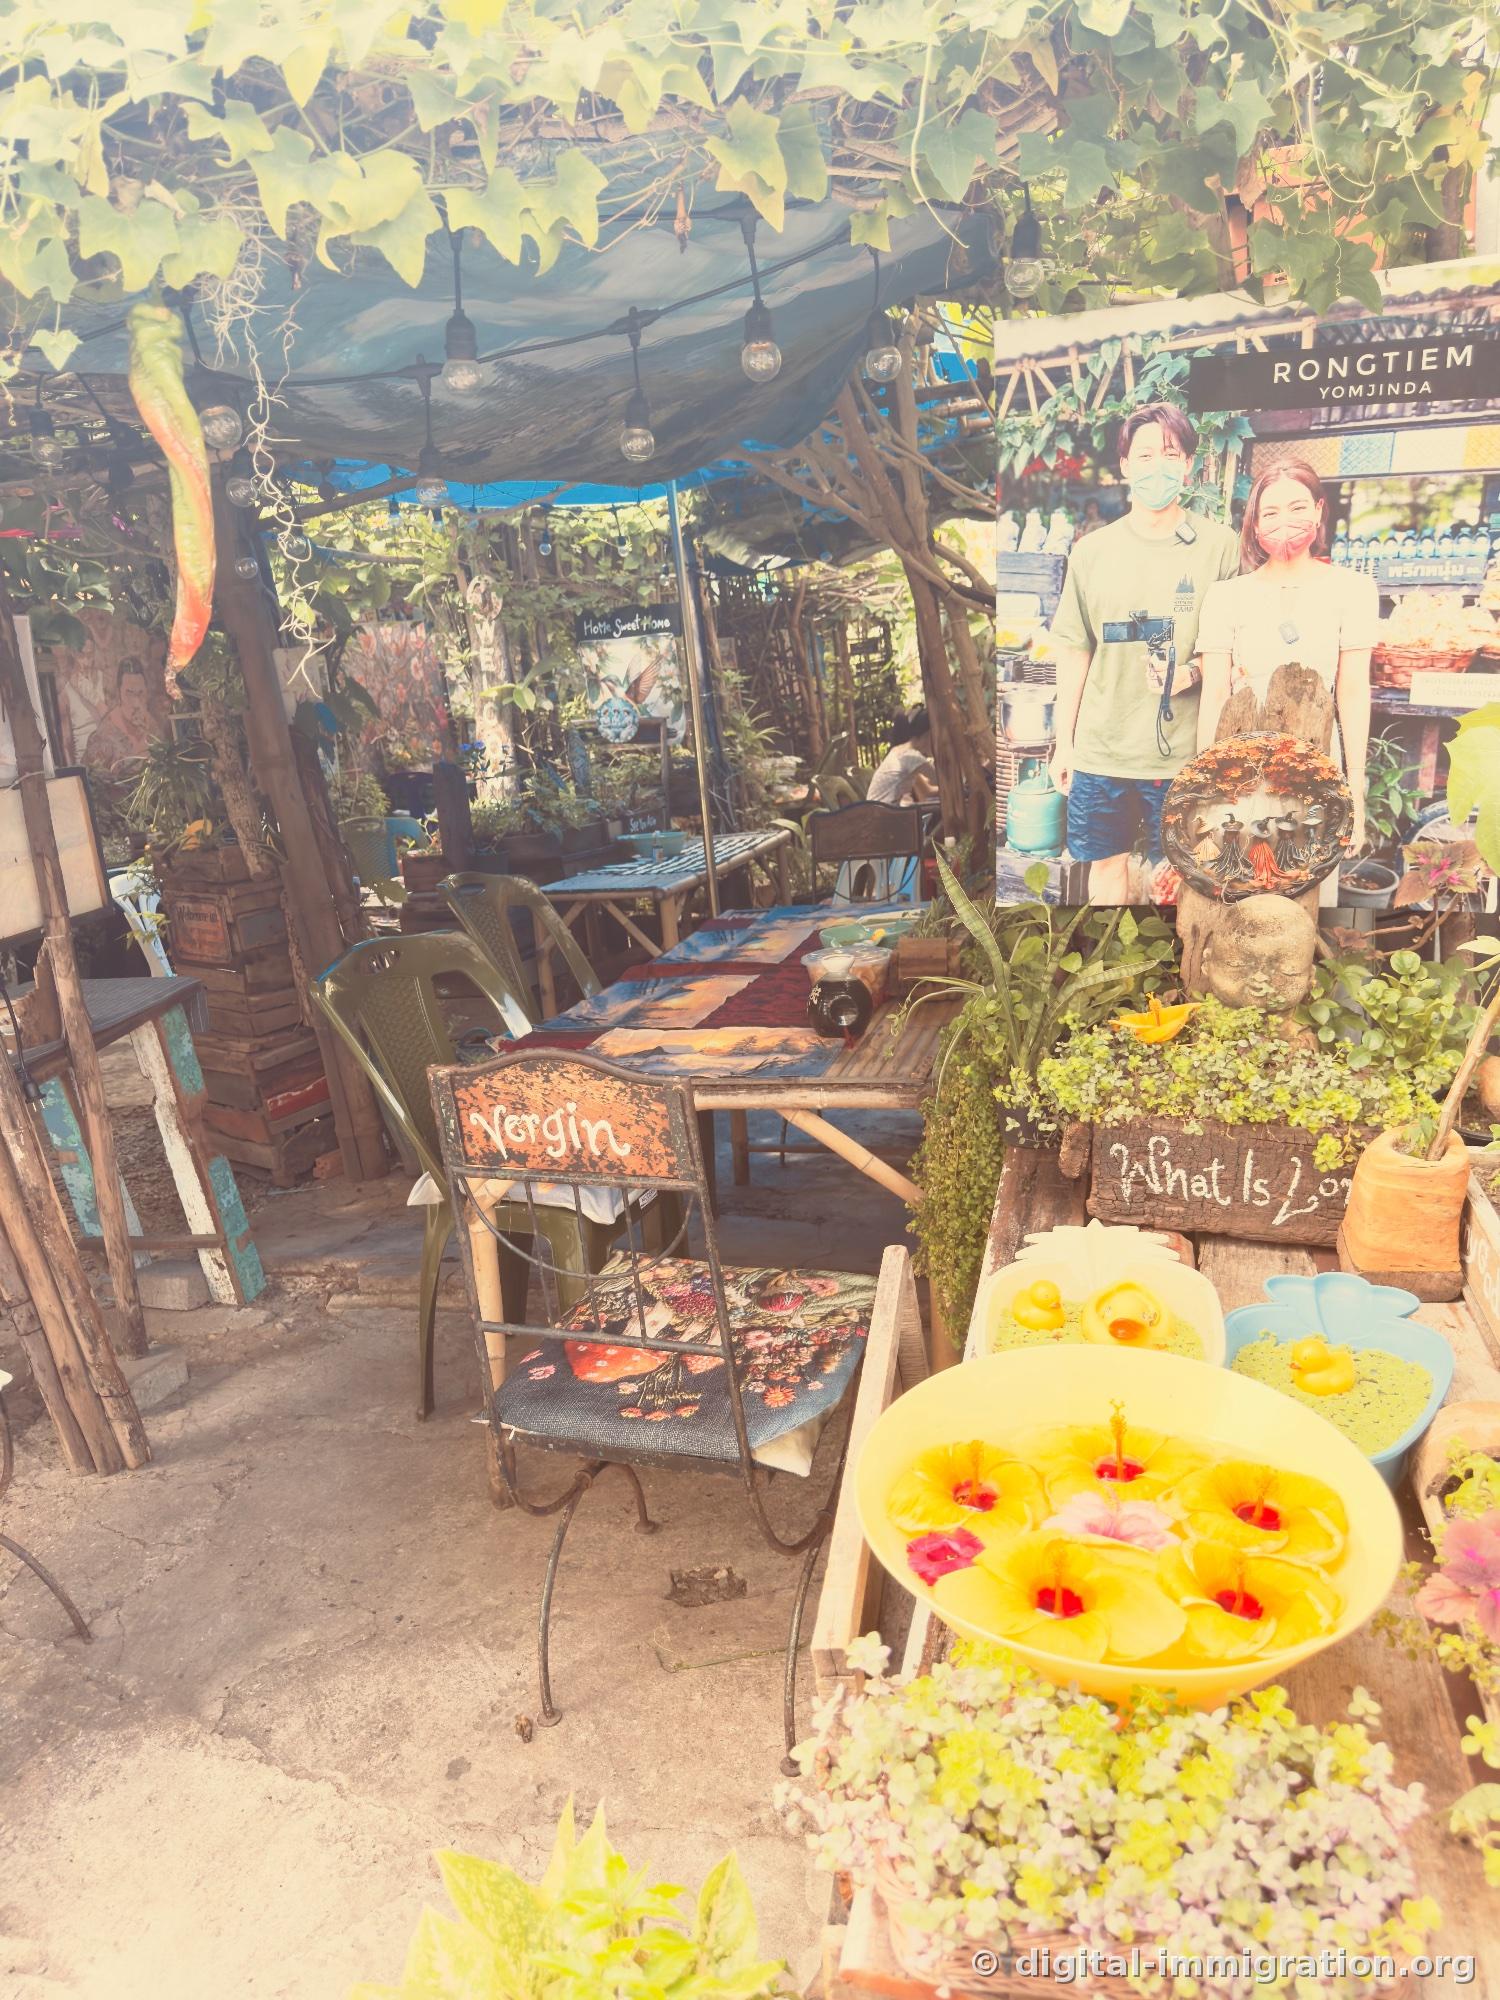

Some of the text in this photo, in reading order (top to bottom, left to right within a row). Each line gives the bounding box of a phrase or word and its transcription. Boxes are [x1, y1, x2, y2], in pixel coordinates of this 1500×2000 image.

[1273, 344, 1474, 384] RONGTIEM
[1319, 380, 1432, 399] YOMJINDA
[613, 613, 641, 638] Sweet
[470, 1102, 632, 1159] Vergin
[1110, 1135, 1232, 1205] What
[1243, 1149, 1270, 1206] Is
